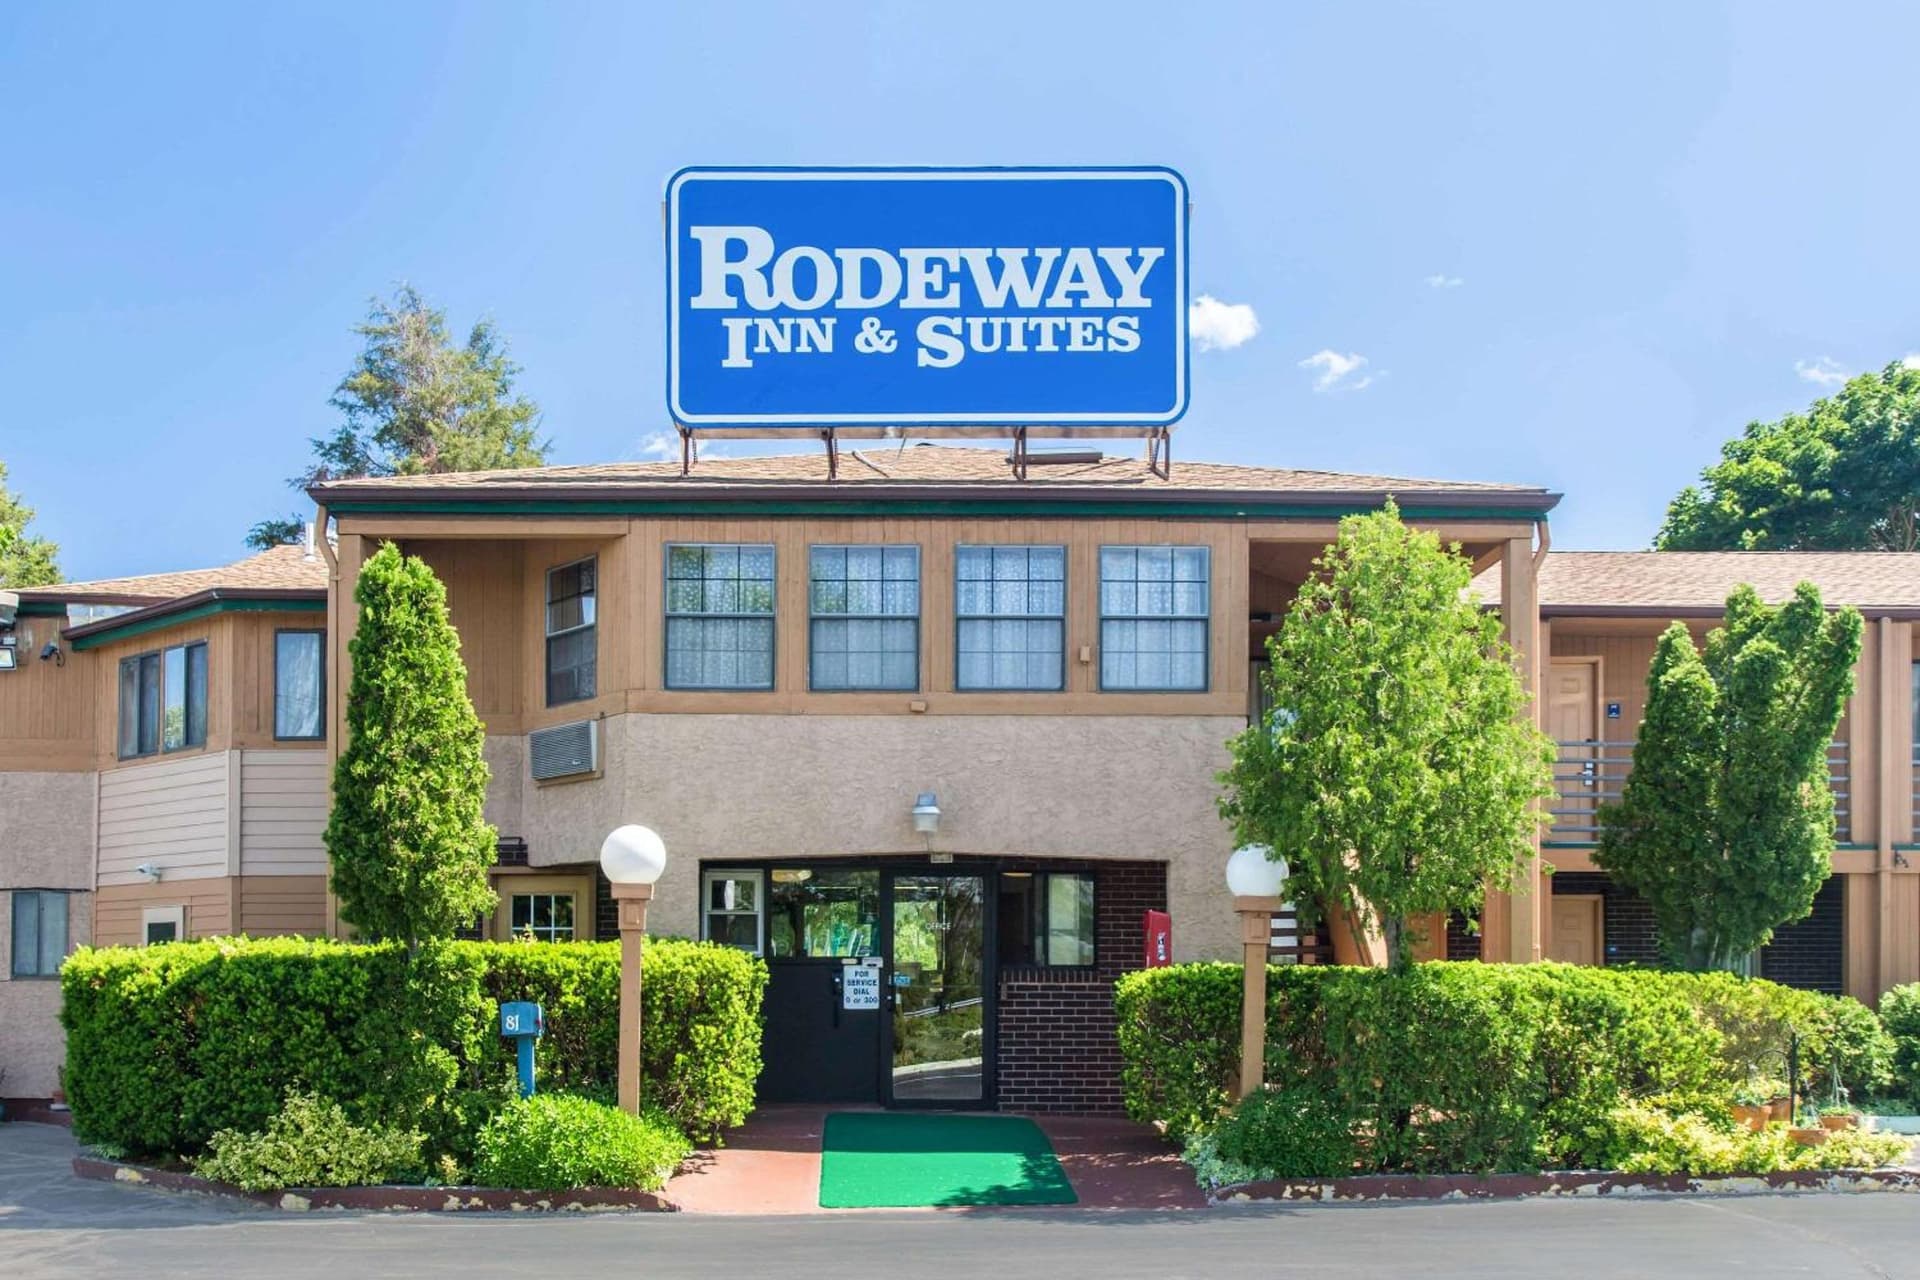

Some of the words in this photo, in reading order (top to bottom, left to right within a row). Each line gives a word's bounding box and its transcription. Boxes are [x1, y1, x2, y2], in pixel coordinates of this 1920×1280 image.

[690, 225, 1165, 311] RODEWAY
[721, 317, 837, 368] INN
[854, 316, 898, 354] &
[916, 315, 1141, 368] SUITES
[505, 1014, 519, 1031] 81
